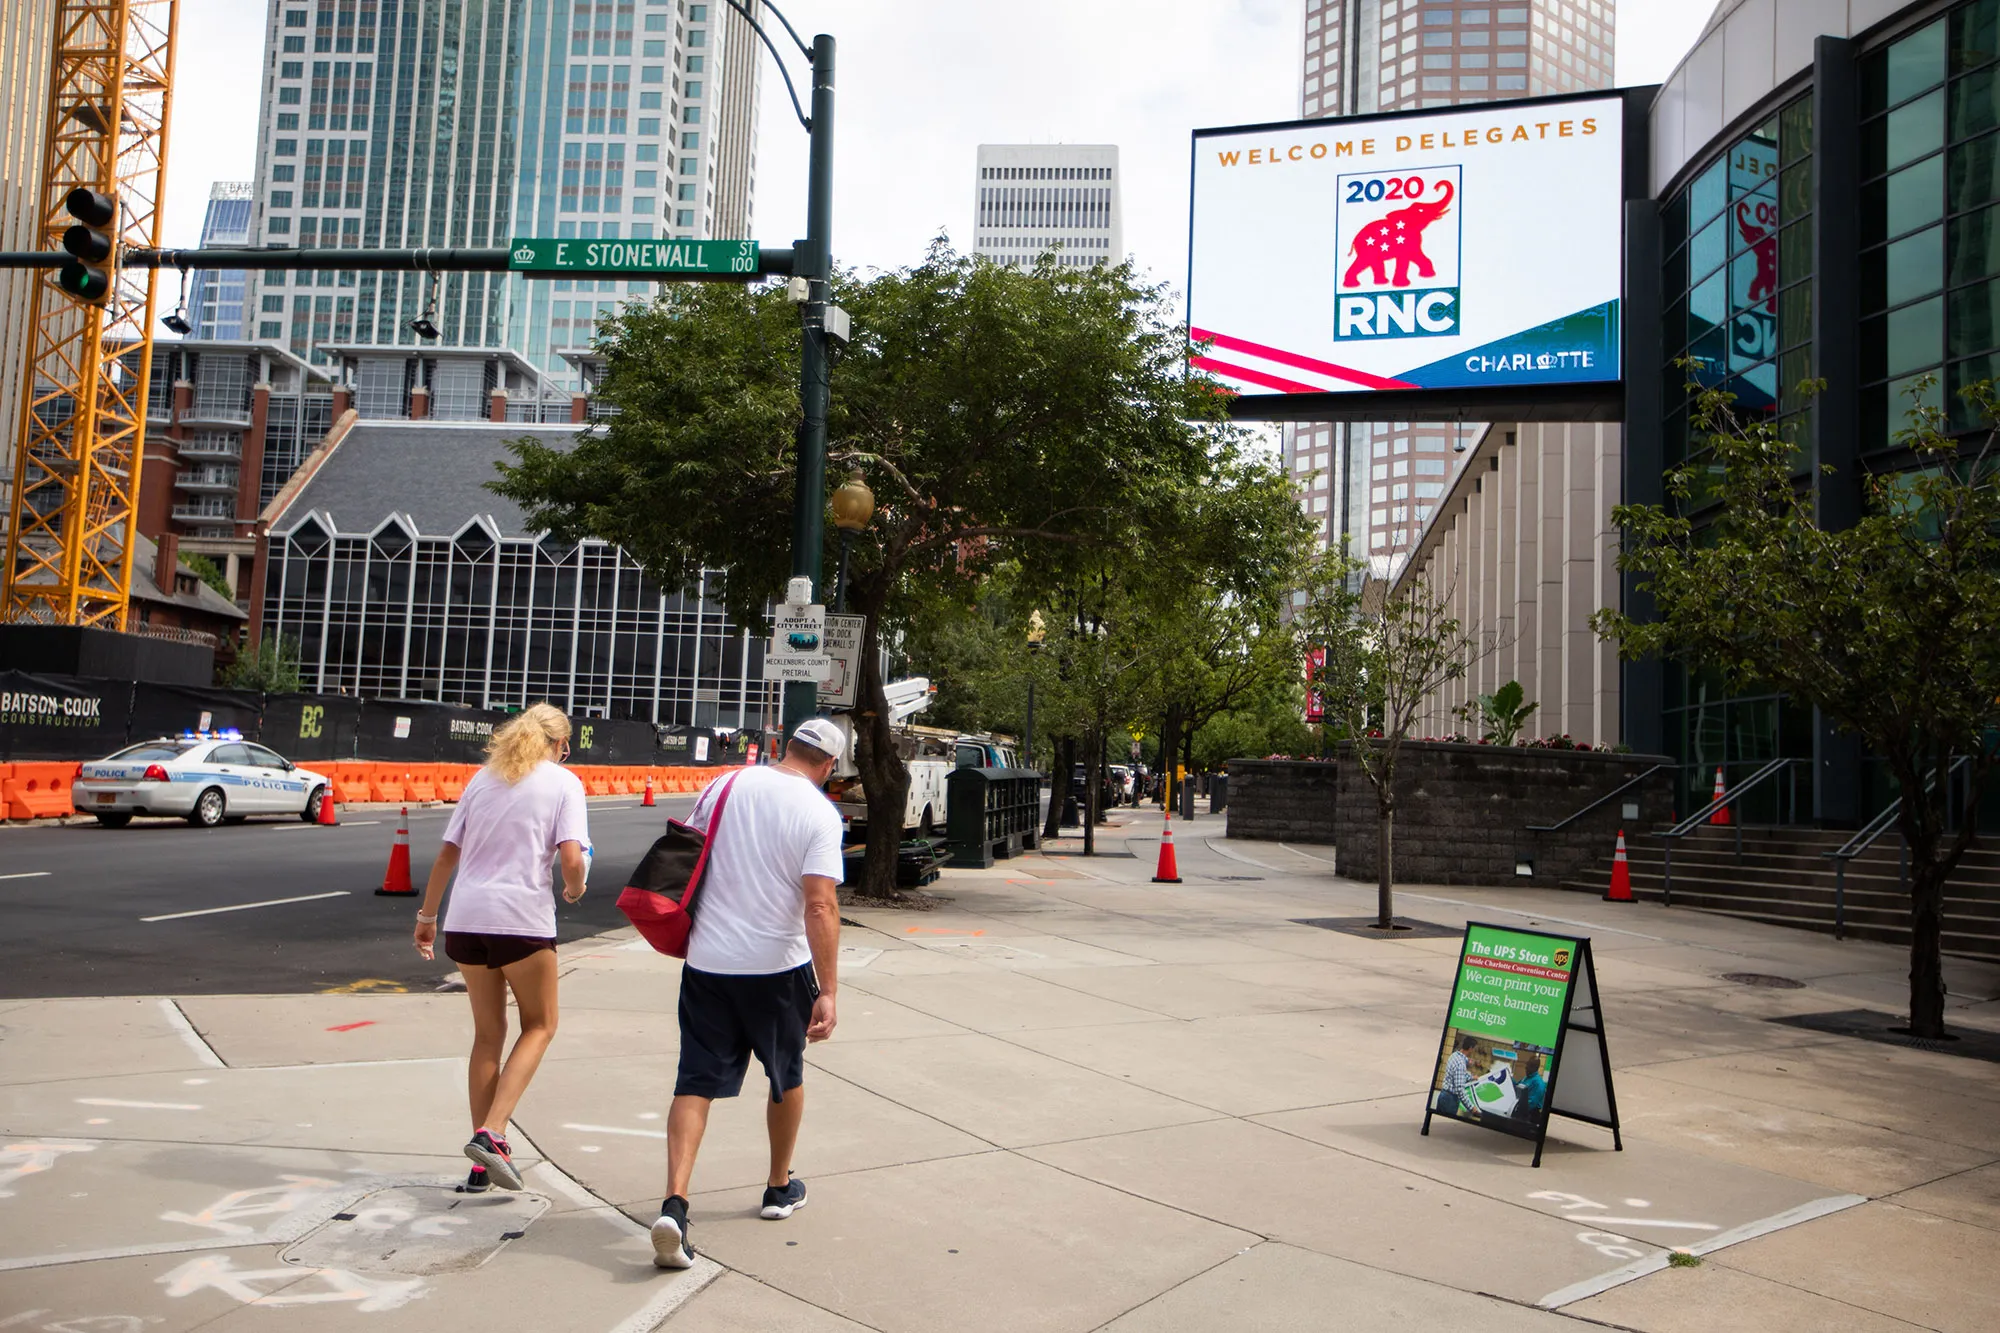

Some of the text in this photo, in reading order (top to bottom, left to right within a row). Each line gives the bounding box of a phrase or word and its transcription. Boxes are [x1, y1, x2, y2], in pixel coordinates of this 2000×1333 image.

[1217, 117, 1599, 167] WELCOME DELEGATES
[1346, 175, 1425, 204] 2020
[556, 243, 709, 269] E. STONEWALL
[739, 241, 755, 256] ST
[731, 257, 754, 272] 100
[1338, 291, 1456, 337] RNC
[1465, 351, 1594, 372] CHARLOTTE
[837, 630, 852, 639] DOCK
[766, 658, 830, 667] MECKLENBURG COUNTY
[781, 669, 812, 678] PRETRIAL
[1, 692, 102, 717] BATSON-COOK
[1, 713, 101, 728] CONSTRUCTION
[300, 705, 324, 739] BC
[450, 719, 494, 736] BATSON-COOK
[450, 732, 491, 743] CONSTRUCTIO
[579, 724, 594, 749] BC
[94, 769, 127, 778] POLICE
[243, 779, 292, 792] POLICE
[1471, 941, 1549, 965] The UPS Store
[1466, 956, 1568, 980] Inside Charlotte Convention Center
[1465, 969, 1561, 998] We can print your
[1460, 989, 1550, 1015] posters, banners
[1456, 1007, 1507, 1027] and signs
